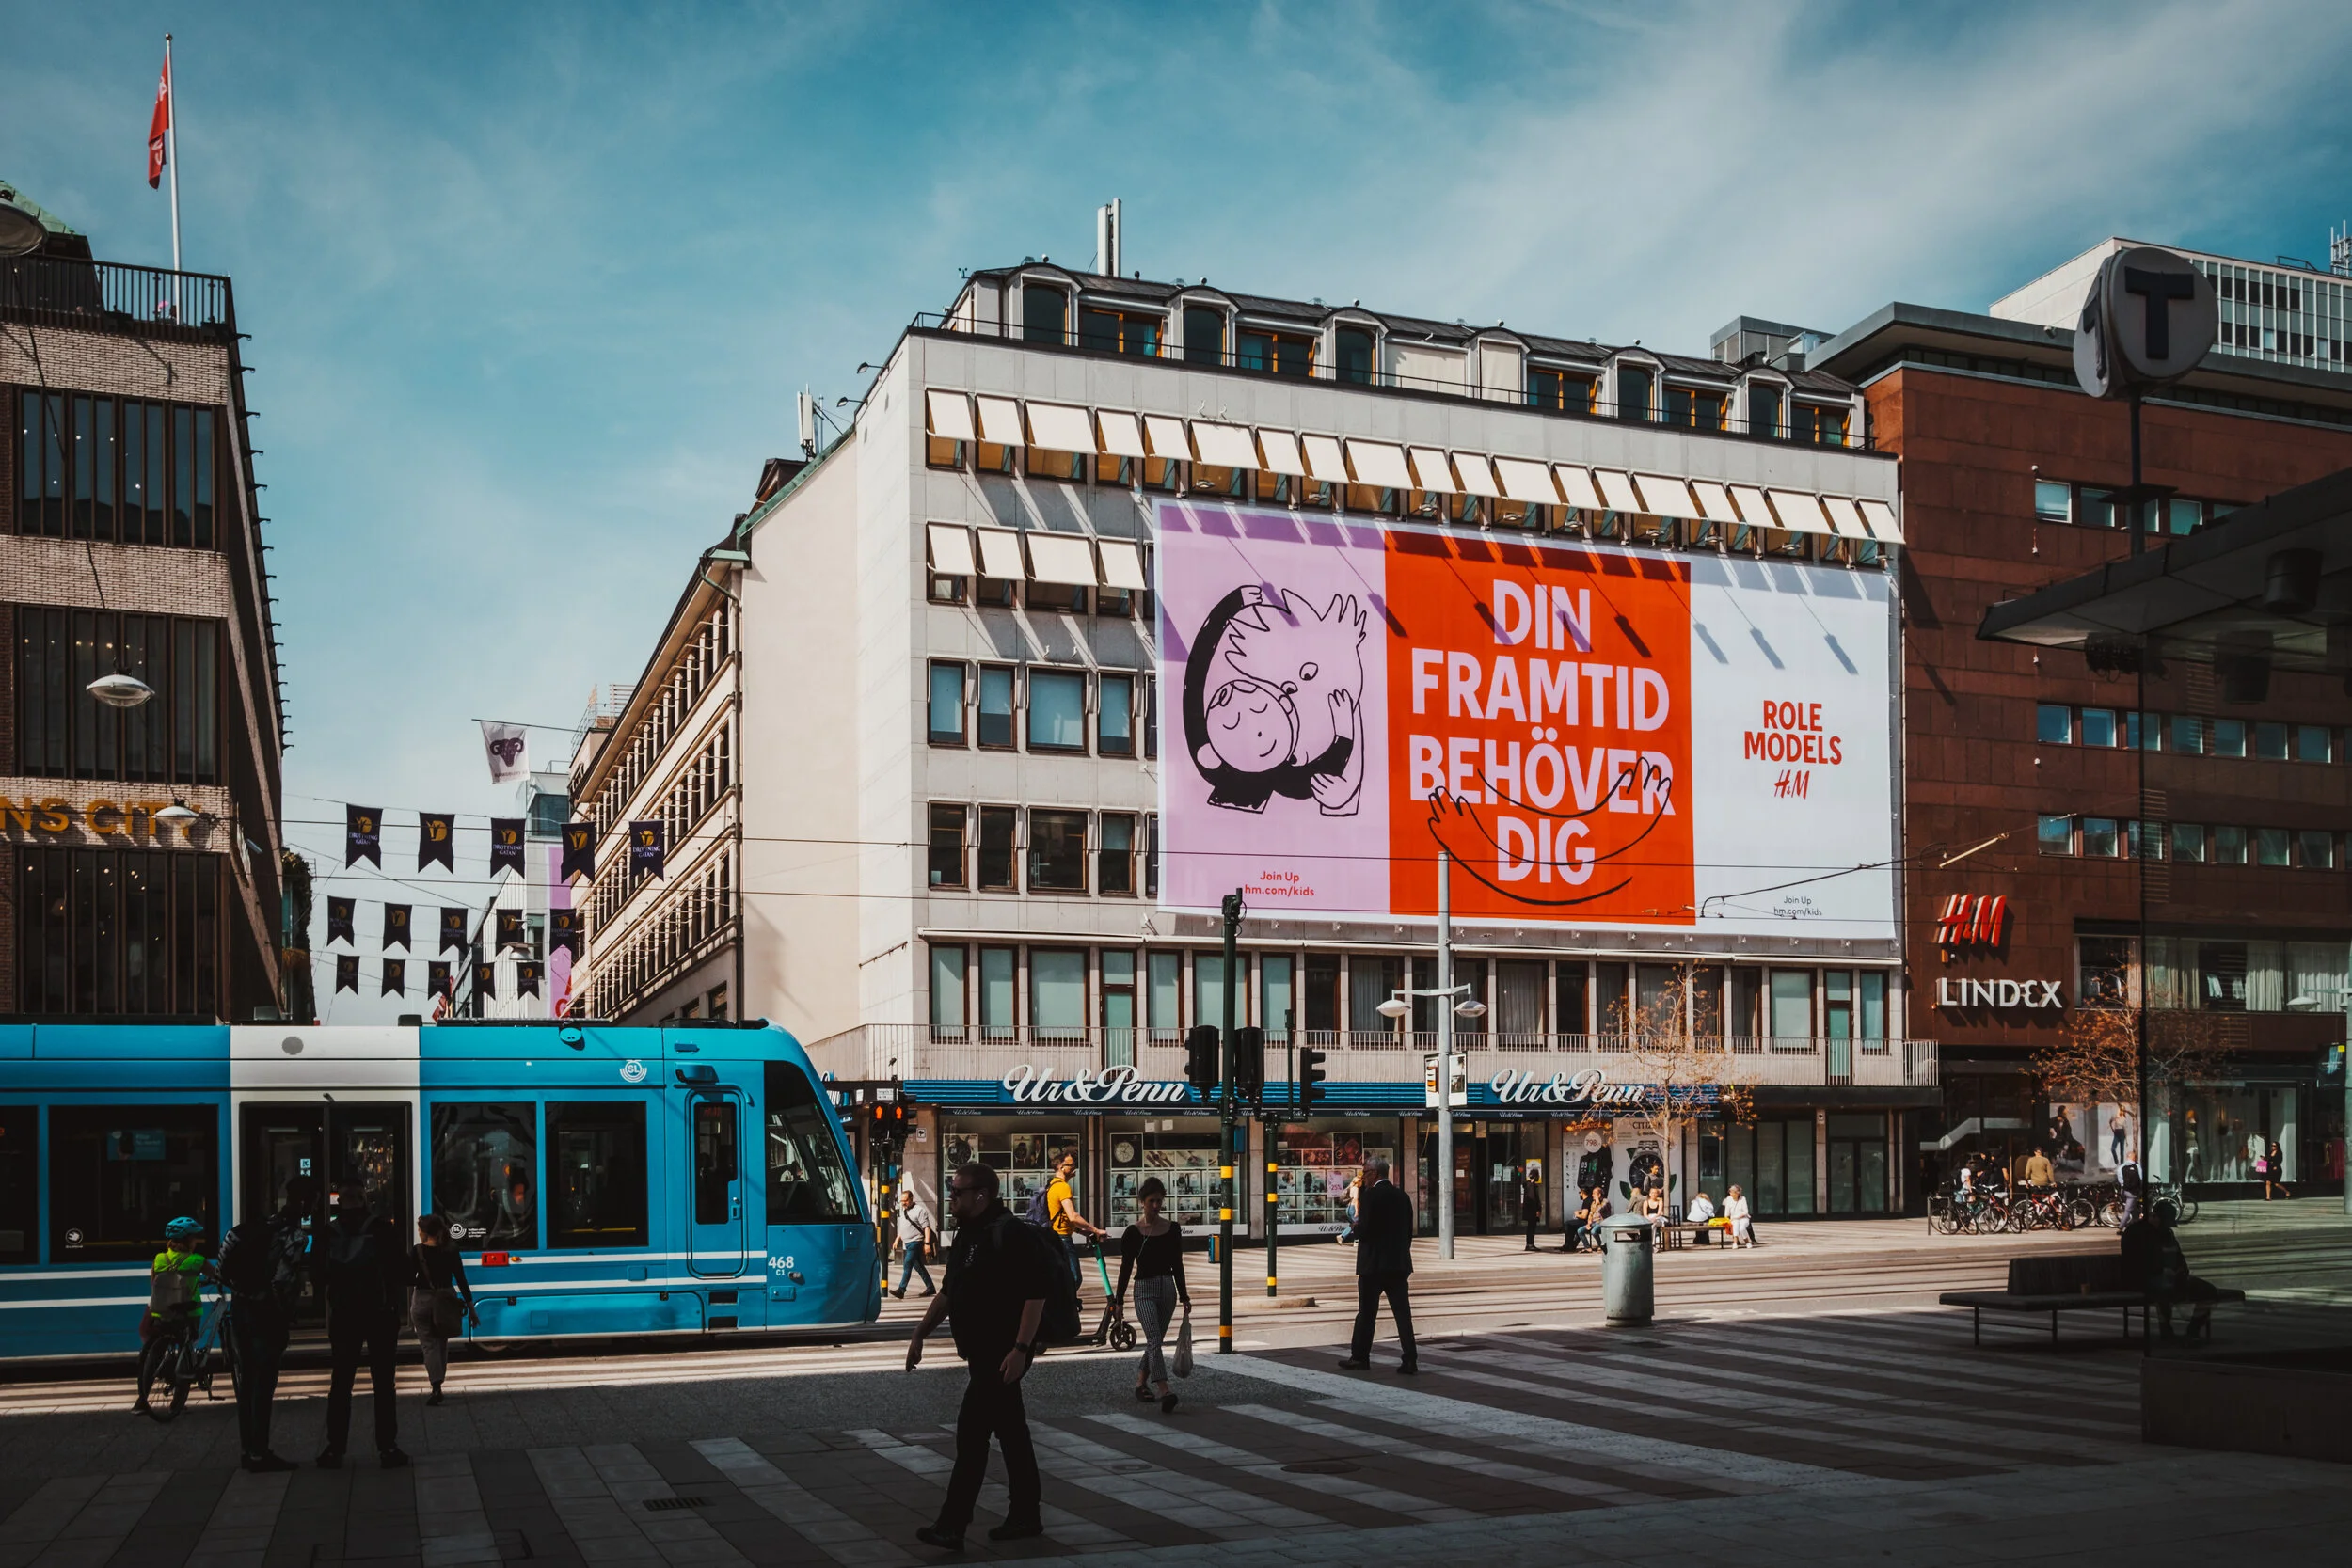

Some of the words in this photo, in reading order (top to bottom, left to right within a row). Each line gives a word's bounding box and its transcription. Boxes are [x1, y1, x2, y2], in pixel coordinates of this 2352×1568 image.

[2124, 266, 2194, 360] T
[1493, 578, 1591, 653] DIN
[1411, 647, 1670, 732] FRAMTID
[1763, 700, 1823, 732] ROLE
[1743, 731, 1843, 766] MODELS
[1409, 726, 1677, 816] BEHÖVER
[1773, 769, 1810, 800] H&M
[1497, 816, 1596, 886] DIG
[1244, 884, 1315, 897] hm.com/kids
[1260, 871, 1282, 881] Join
[1284, 872, 1300, 884] Up
[1773, 906, 1823, 917] hm.com/kids
[1783, 895, 1800, 905] Join
[1801, 896, 1812, 907] Up
[1937, 894, 2007, 947] H&M
[1938, 977, 2063, 1009] LINDEX
[628, 1064, 640, 1074] SL
[1003, 1064, 1186, 1102] Ur&Penn
[1490, 1068, 1645, 1103] Ur&Penn
[768, 1256, 795, 1269] 468
